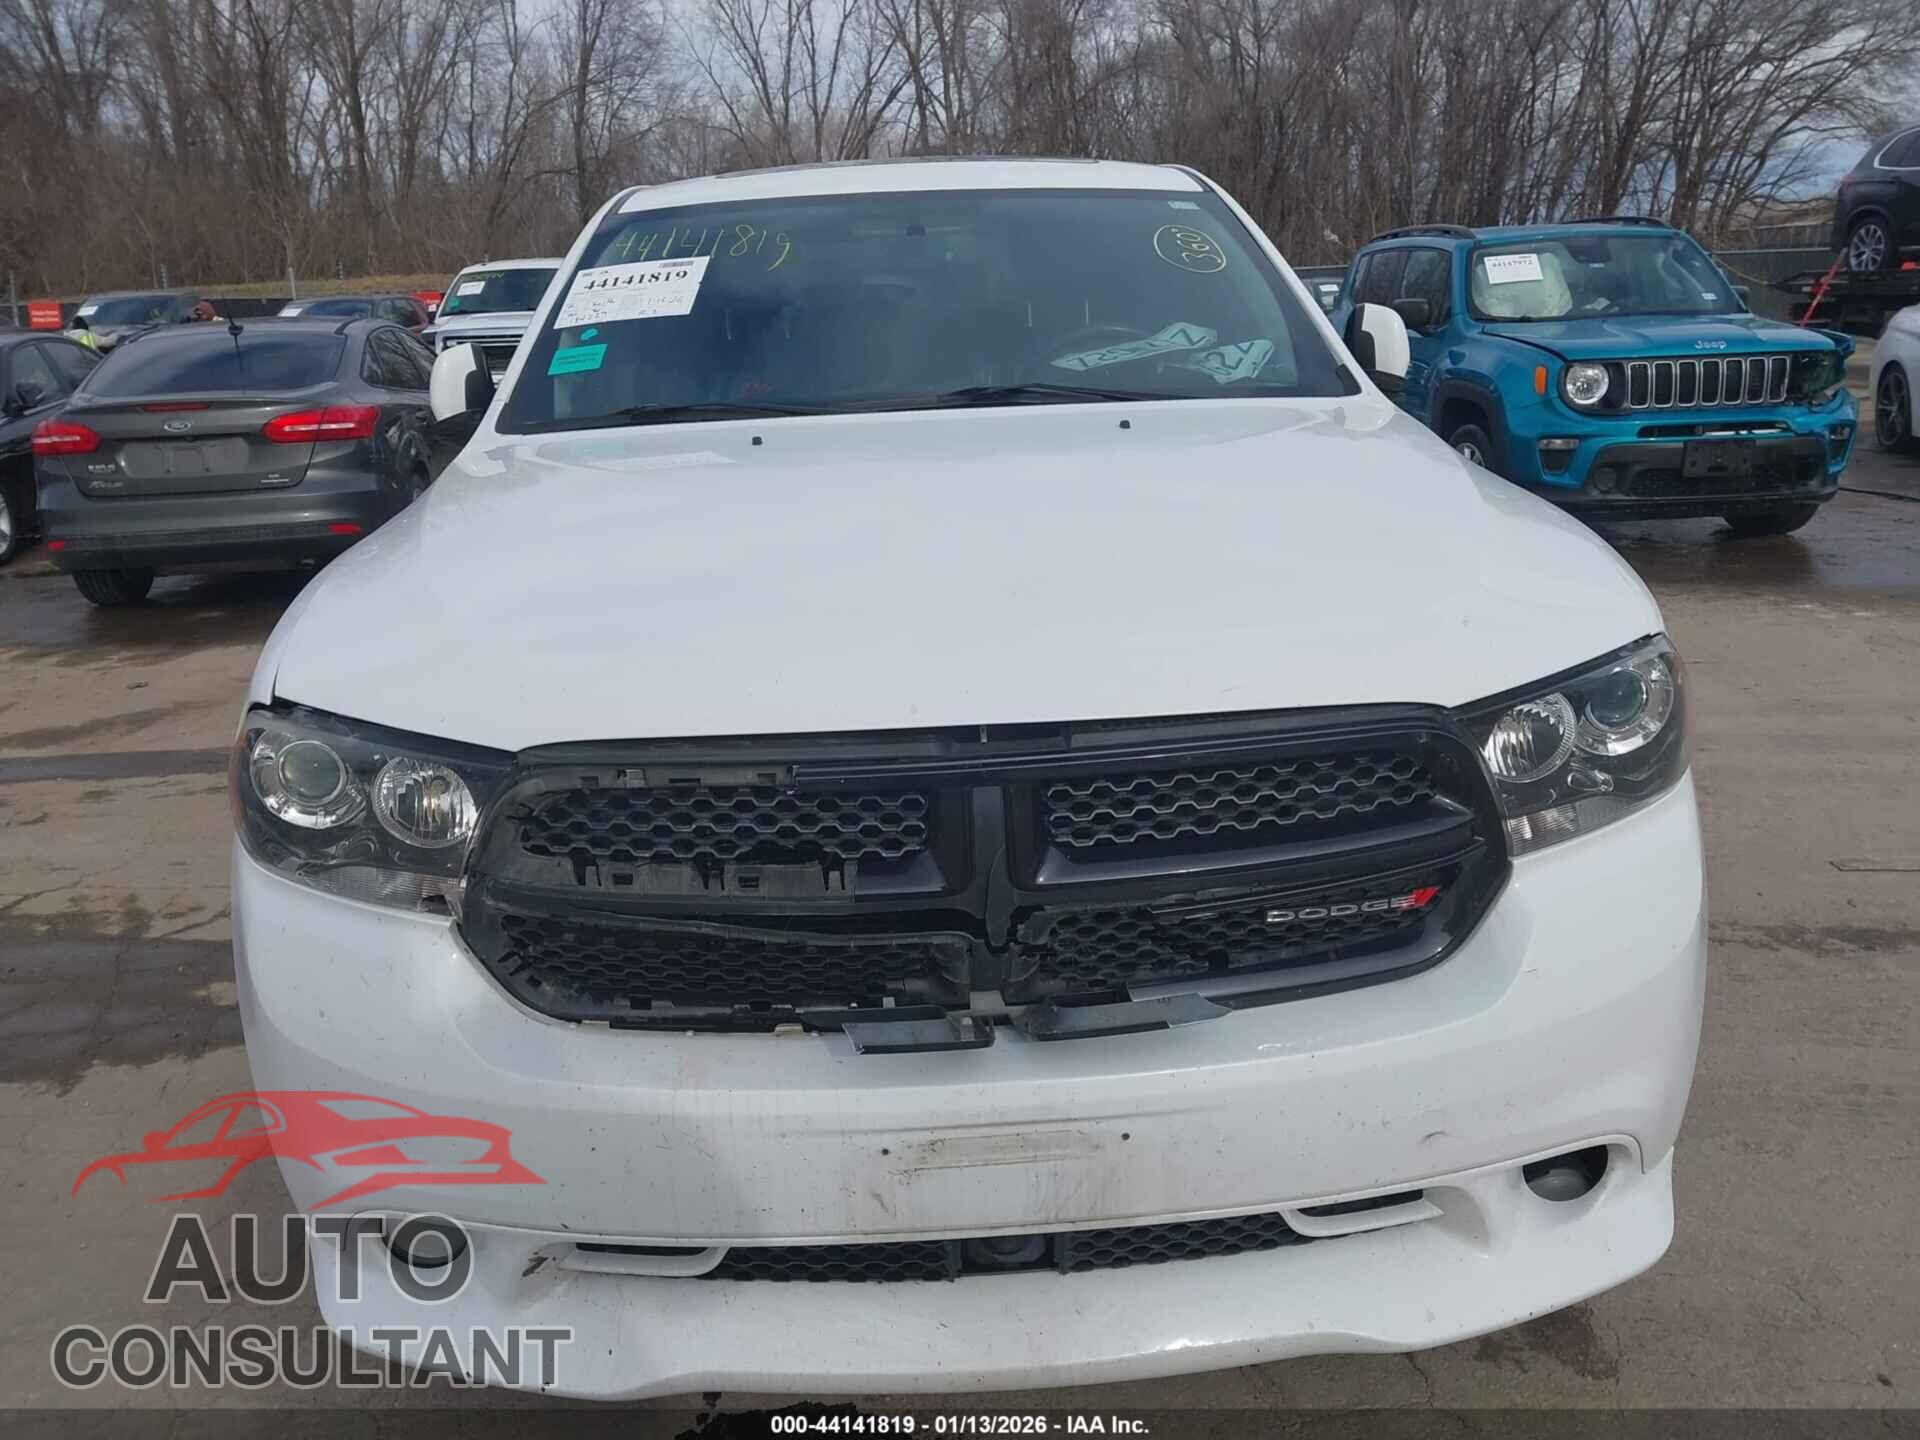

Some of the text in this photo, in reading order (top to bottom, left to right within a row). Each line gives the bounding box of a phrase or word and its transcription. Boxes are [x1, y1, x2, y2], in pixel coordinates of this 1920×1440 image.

[614, 224, 792, 271] 44141819
[583, 270, 688, 291] 44141819
[1694, 339, 1727, 350] Jeep
[1266, 894, 1416, 922] DODGE
